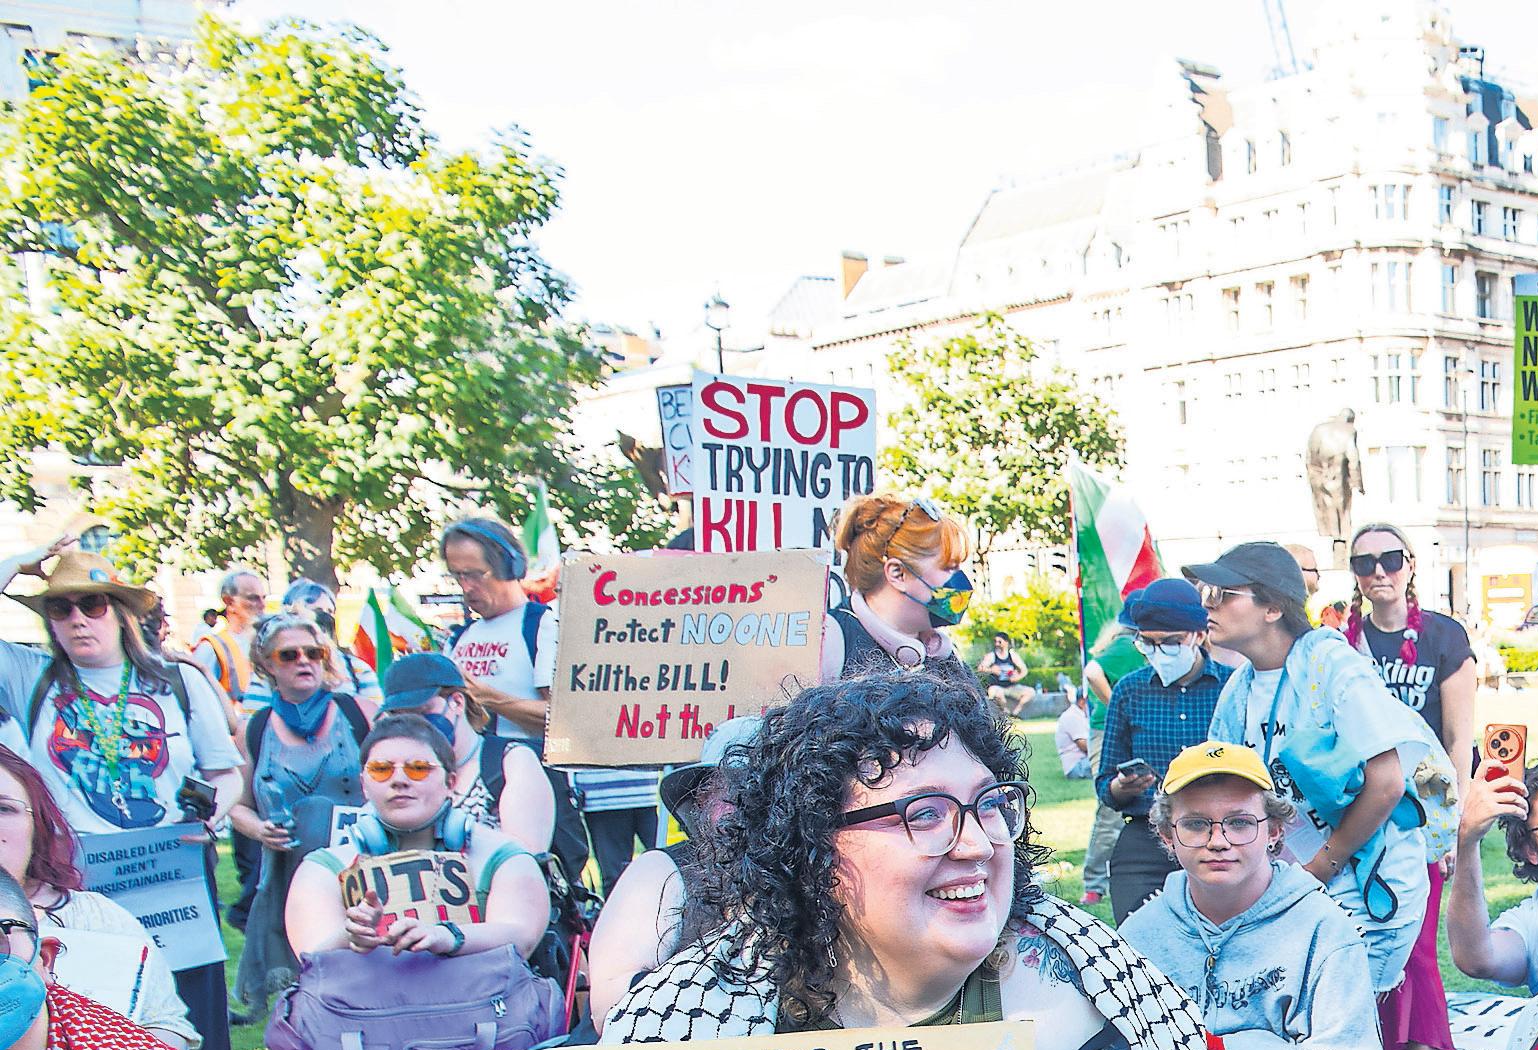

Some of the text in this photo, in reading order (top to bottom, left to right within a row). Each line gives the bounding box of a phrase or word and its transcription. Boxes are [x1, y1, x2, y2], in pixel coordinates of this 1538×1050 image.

[701, 381, 869, 449] STOP
[702, 443, 832, 500] TRYING
[838, 453, 874, 501] TO
[593, 617, 675, 644] Protect
[657, 660, 729, 692] BILL!
[615, 703, 670, 740] Not
[679, 703, 714, 740] the
[87, 838, 181, 865] DISABLED LIVES
